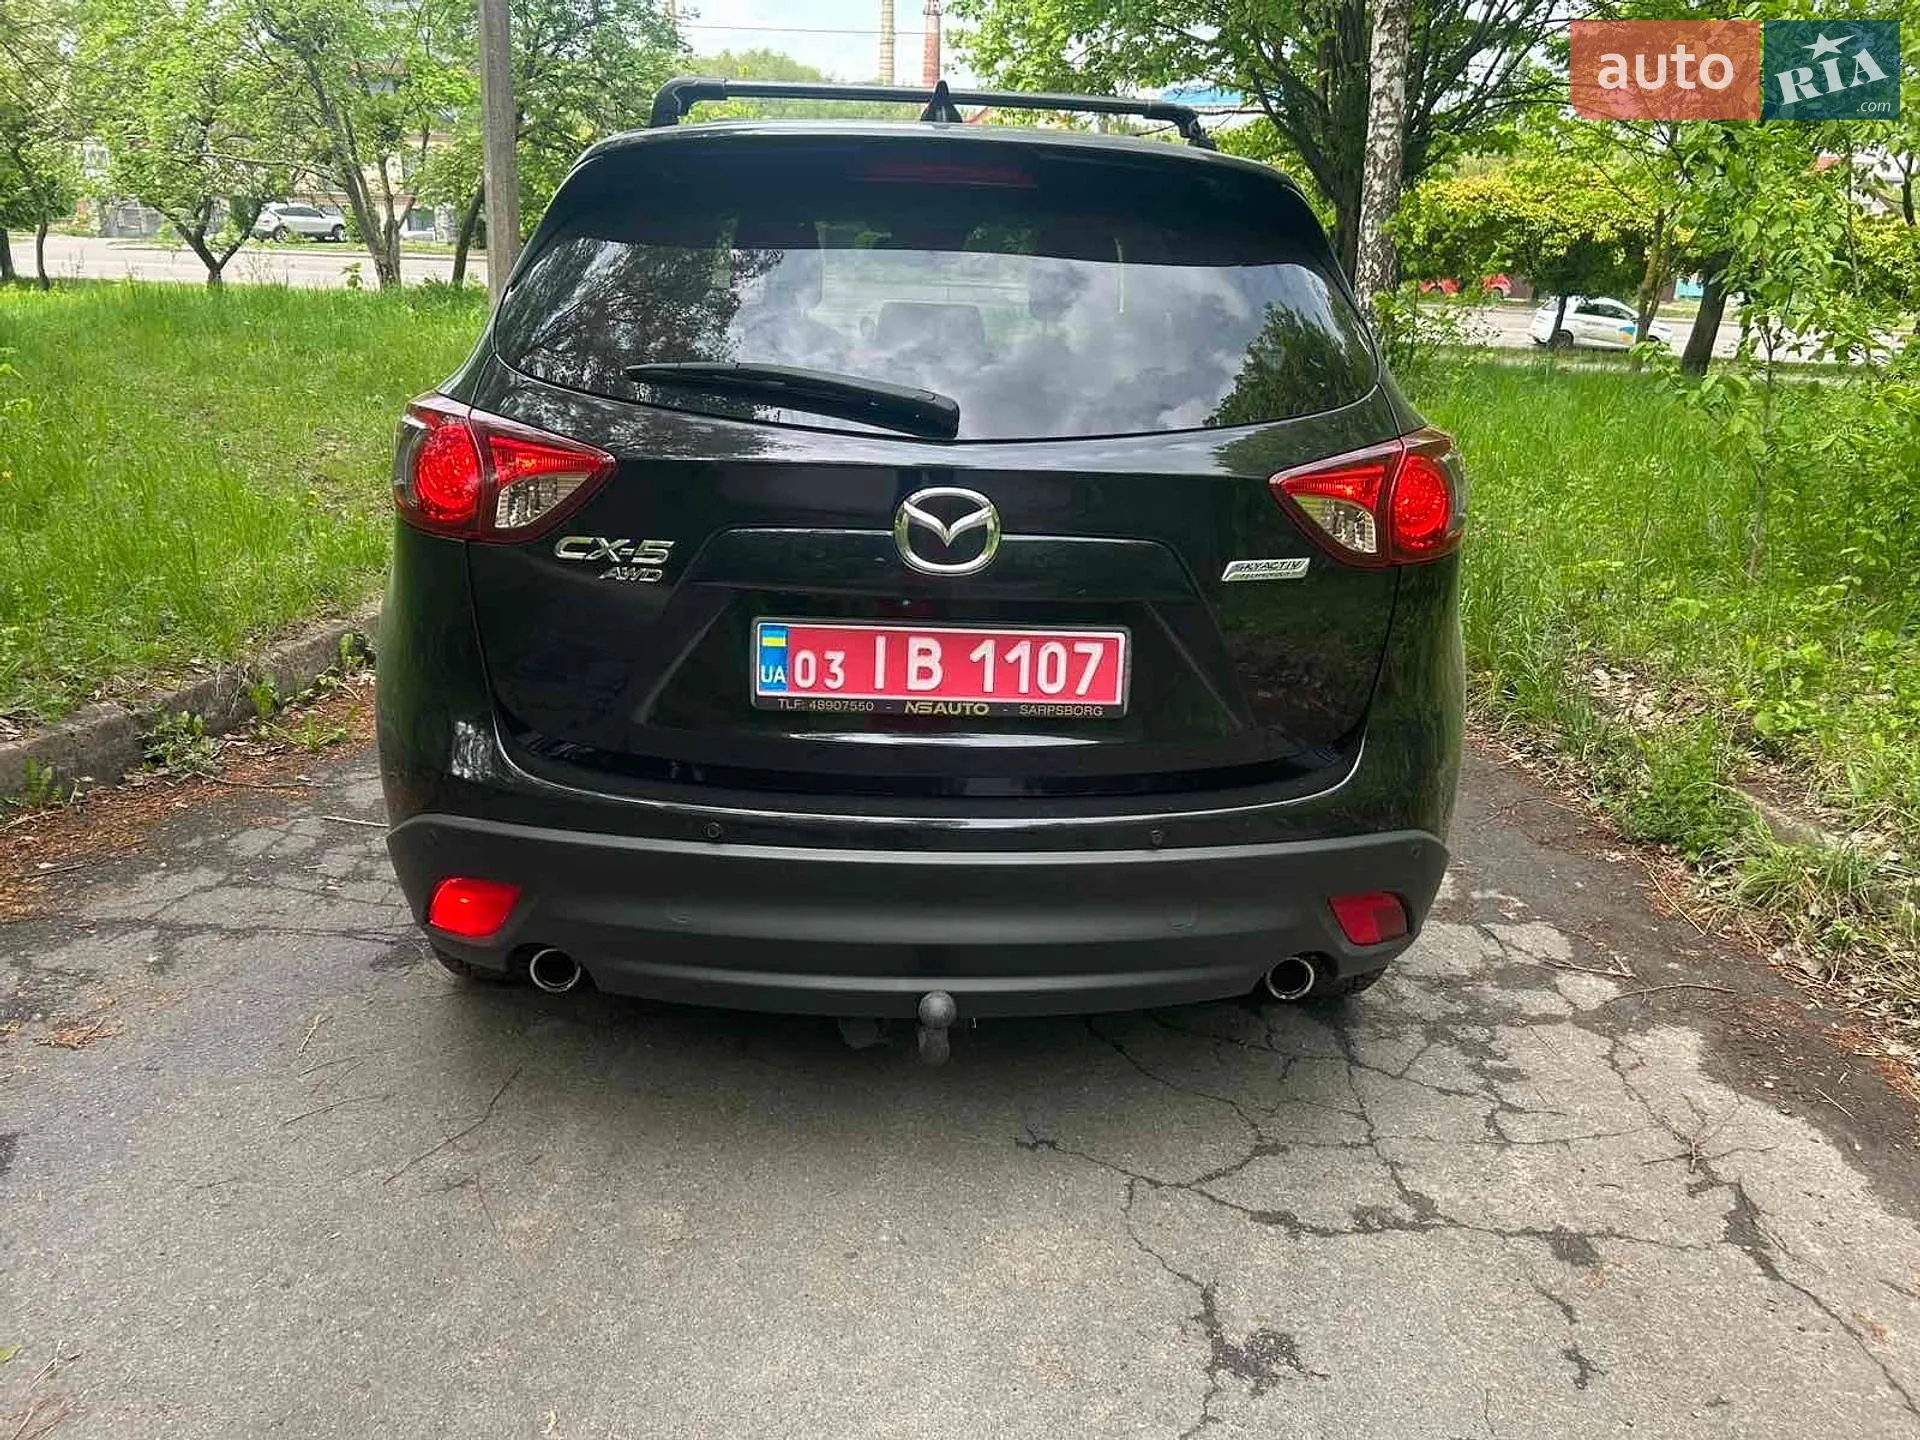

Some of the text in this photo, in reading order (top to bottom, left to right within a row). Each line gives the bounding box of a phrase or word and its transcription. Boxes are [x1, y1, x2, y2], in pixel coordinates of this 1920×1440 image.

[554, 536, 675, 564] CX-5
[598, 566, 663, 582] AWD
[761, 664, 786, 684] UA
[794, 635, 1105, 696] 03 IB 1107
[808, 700, 875, 712] 48907550
[903, 701, 990, 716] NSAUTO
[1019, 704, 1104, 718] SARPSBORG
